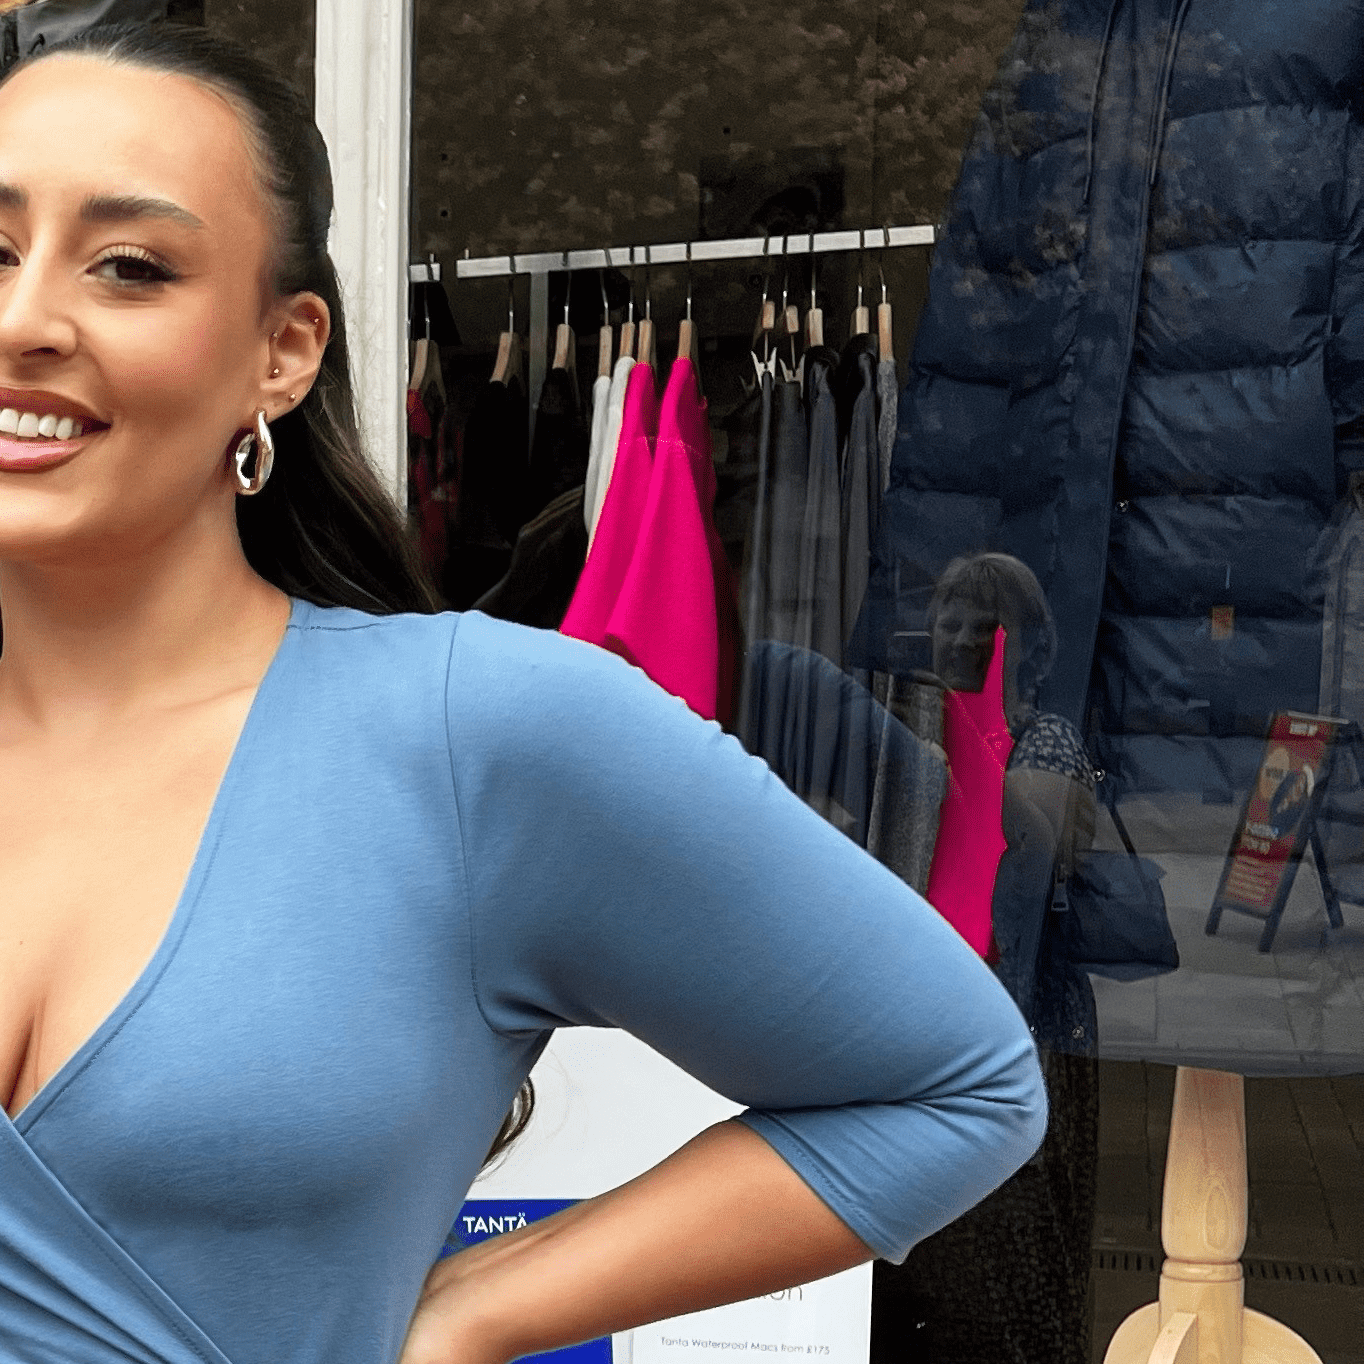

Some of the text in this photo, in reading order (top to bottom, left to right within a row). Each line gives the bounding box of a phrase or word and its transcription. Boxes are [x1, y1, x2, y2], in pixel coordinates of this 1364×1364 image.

[691, 1338, 748, 1350] Waterproof
[750, 1341, 778, 1352] Macs
[781, 1343, 804, 1353] from
